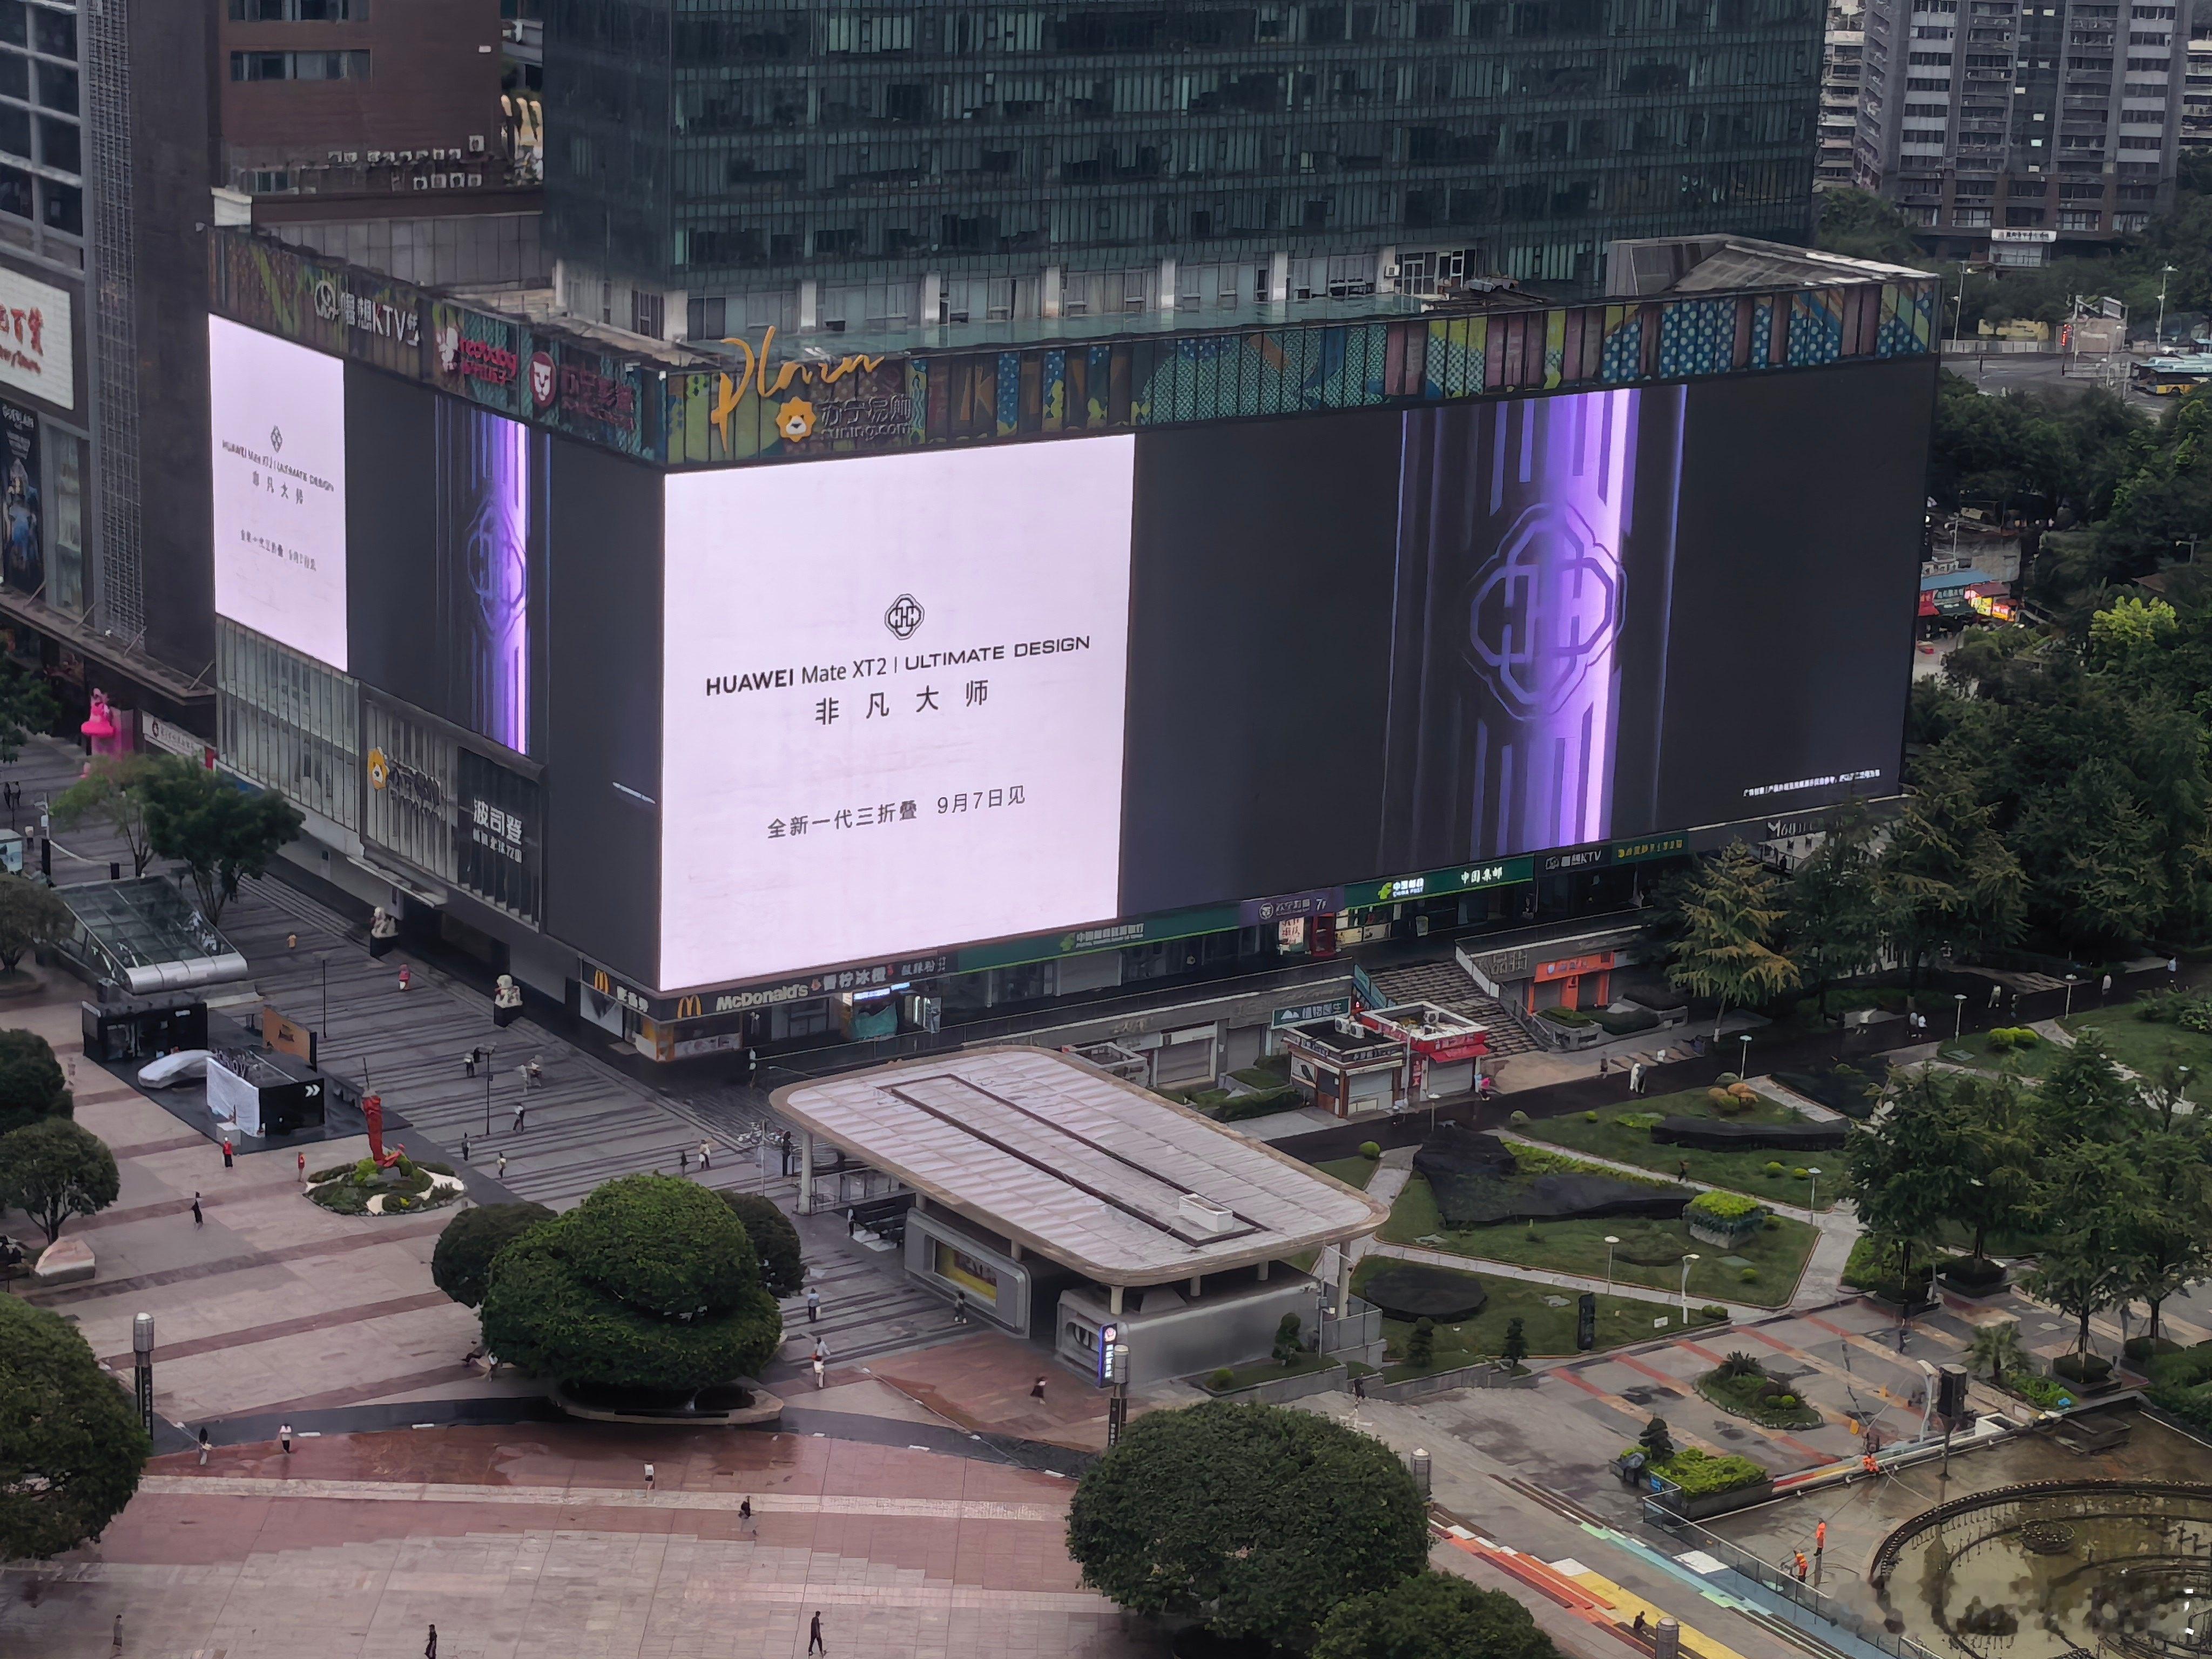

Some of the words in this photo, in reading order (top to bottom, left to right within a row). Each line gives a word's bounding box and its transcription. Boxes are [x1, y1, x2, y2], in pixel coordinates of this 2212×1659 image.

[706, 669, 793, 696] HUAWEI
[802, 665, 846, 684] Mate
[852, 658, 886, 678] XT2
[905, 647, 1004, 670] ULTIMATE
[1014, 635, 1090, 657] DESIGN
[815, 680, 988, 725] 非凡大师
[474, 797, 522, 845] 波司登
[767, 800, 916, 839] 全新一代三折叠
[938, 785, 1025, 814] 9月7日见
[716, 984, 808, 1011] McDonald's
